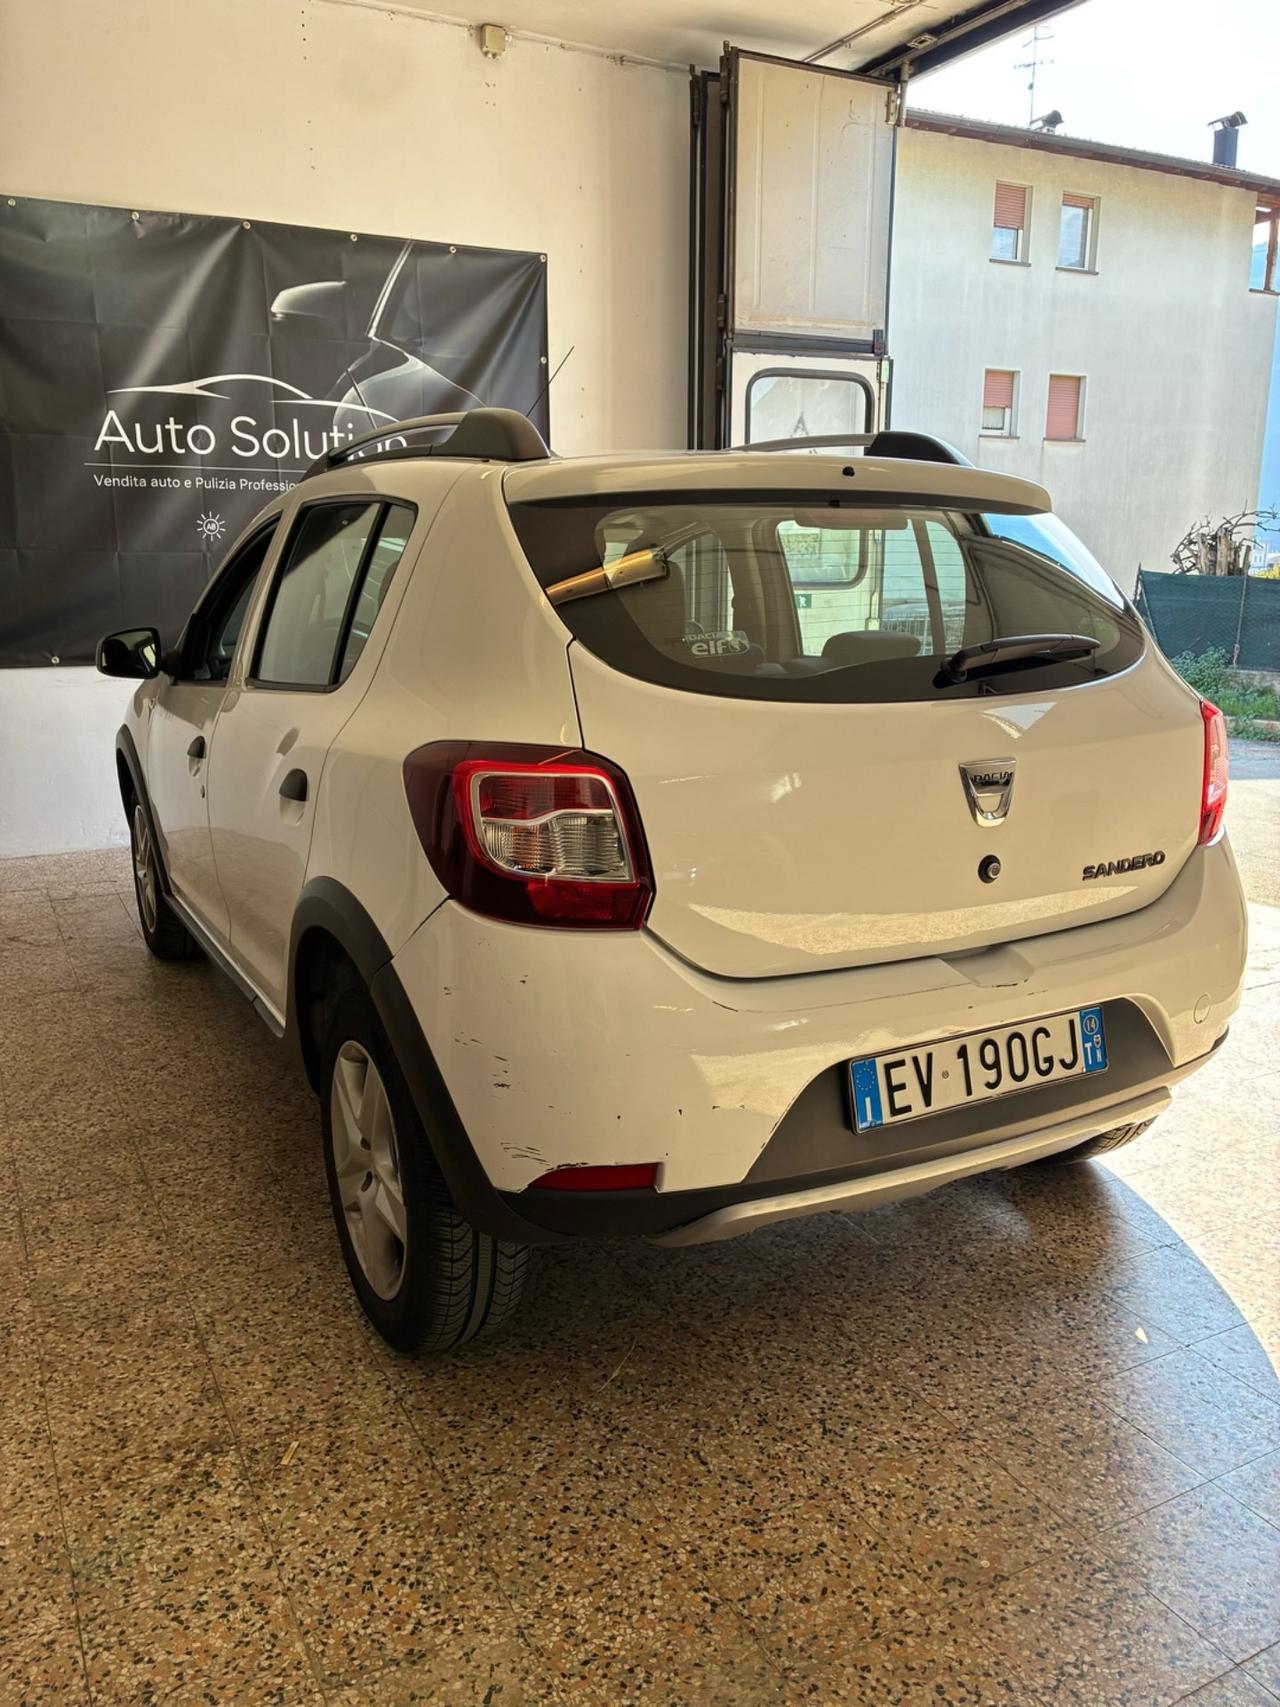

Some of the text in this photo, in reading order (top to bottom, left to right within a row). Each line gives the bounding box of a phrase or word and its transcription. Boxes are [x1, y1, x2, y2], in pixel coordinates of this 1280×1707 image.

[94, 409, 216, 455] Auto
[93, 474, 297, 491] Vendita auto e Pulizia Professio
[691, 640, 727, 655] elf
[973, 771, 1014, 785] DACIA
[1082, 850, 1166, 881] SANDERO
[884, 1052, 934, 1117] EV
[957, 1018, 1079, 1097] 190GJ
